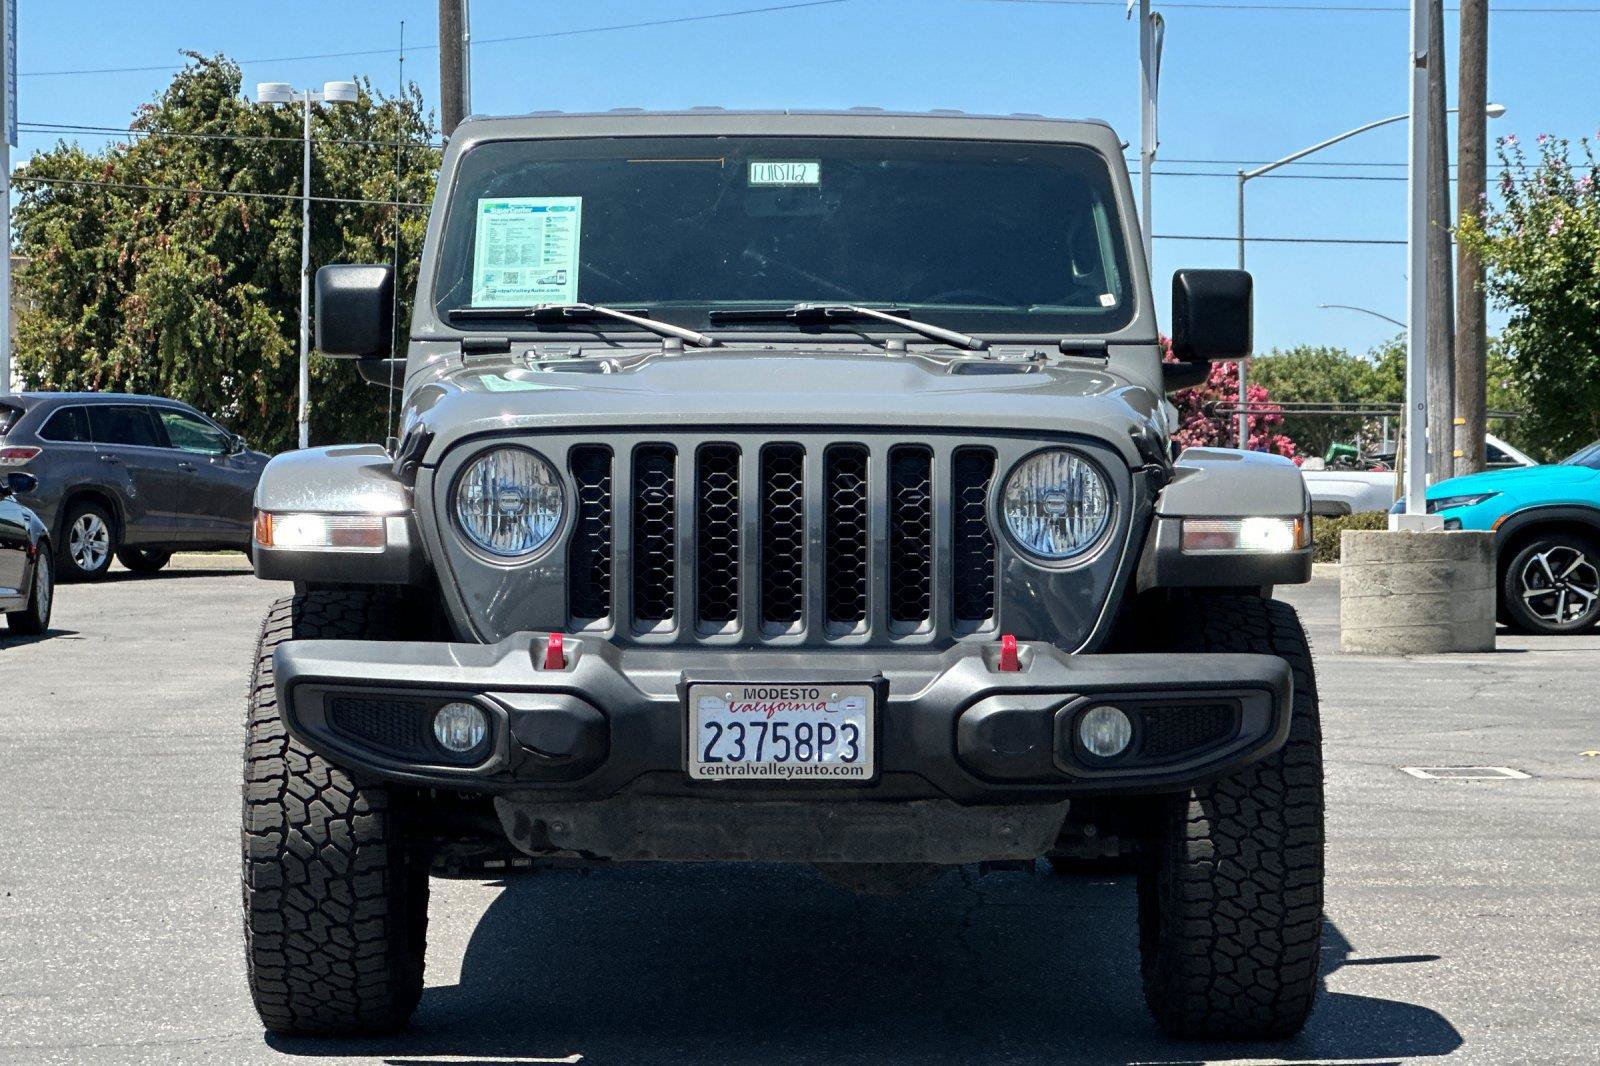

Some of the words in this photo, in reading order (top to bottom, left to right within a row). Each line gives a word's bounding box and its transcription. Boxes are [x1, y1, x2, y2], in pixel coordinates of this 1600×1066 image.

[744, 688, 820, 700] MODESTO
[729, 701, 839, 719] California
[703, 721, 859, 763] 23758P3
[699, 763, 864, 778] centralvalleyauto.com
